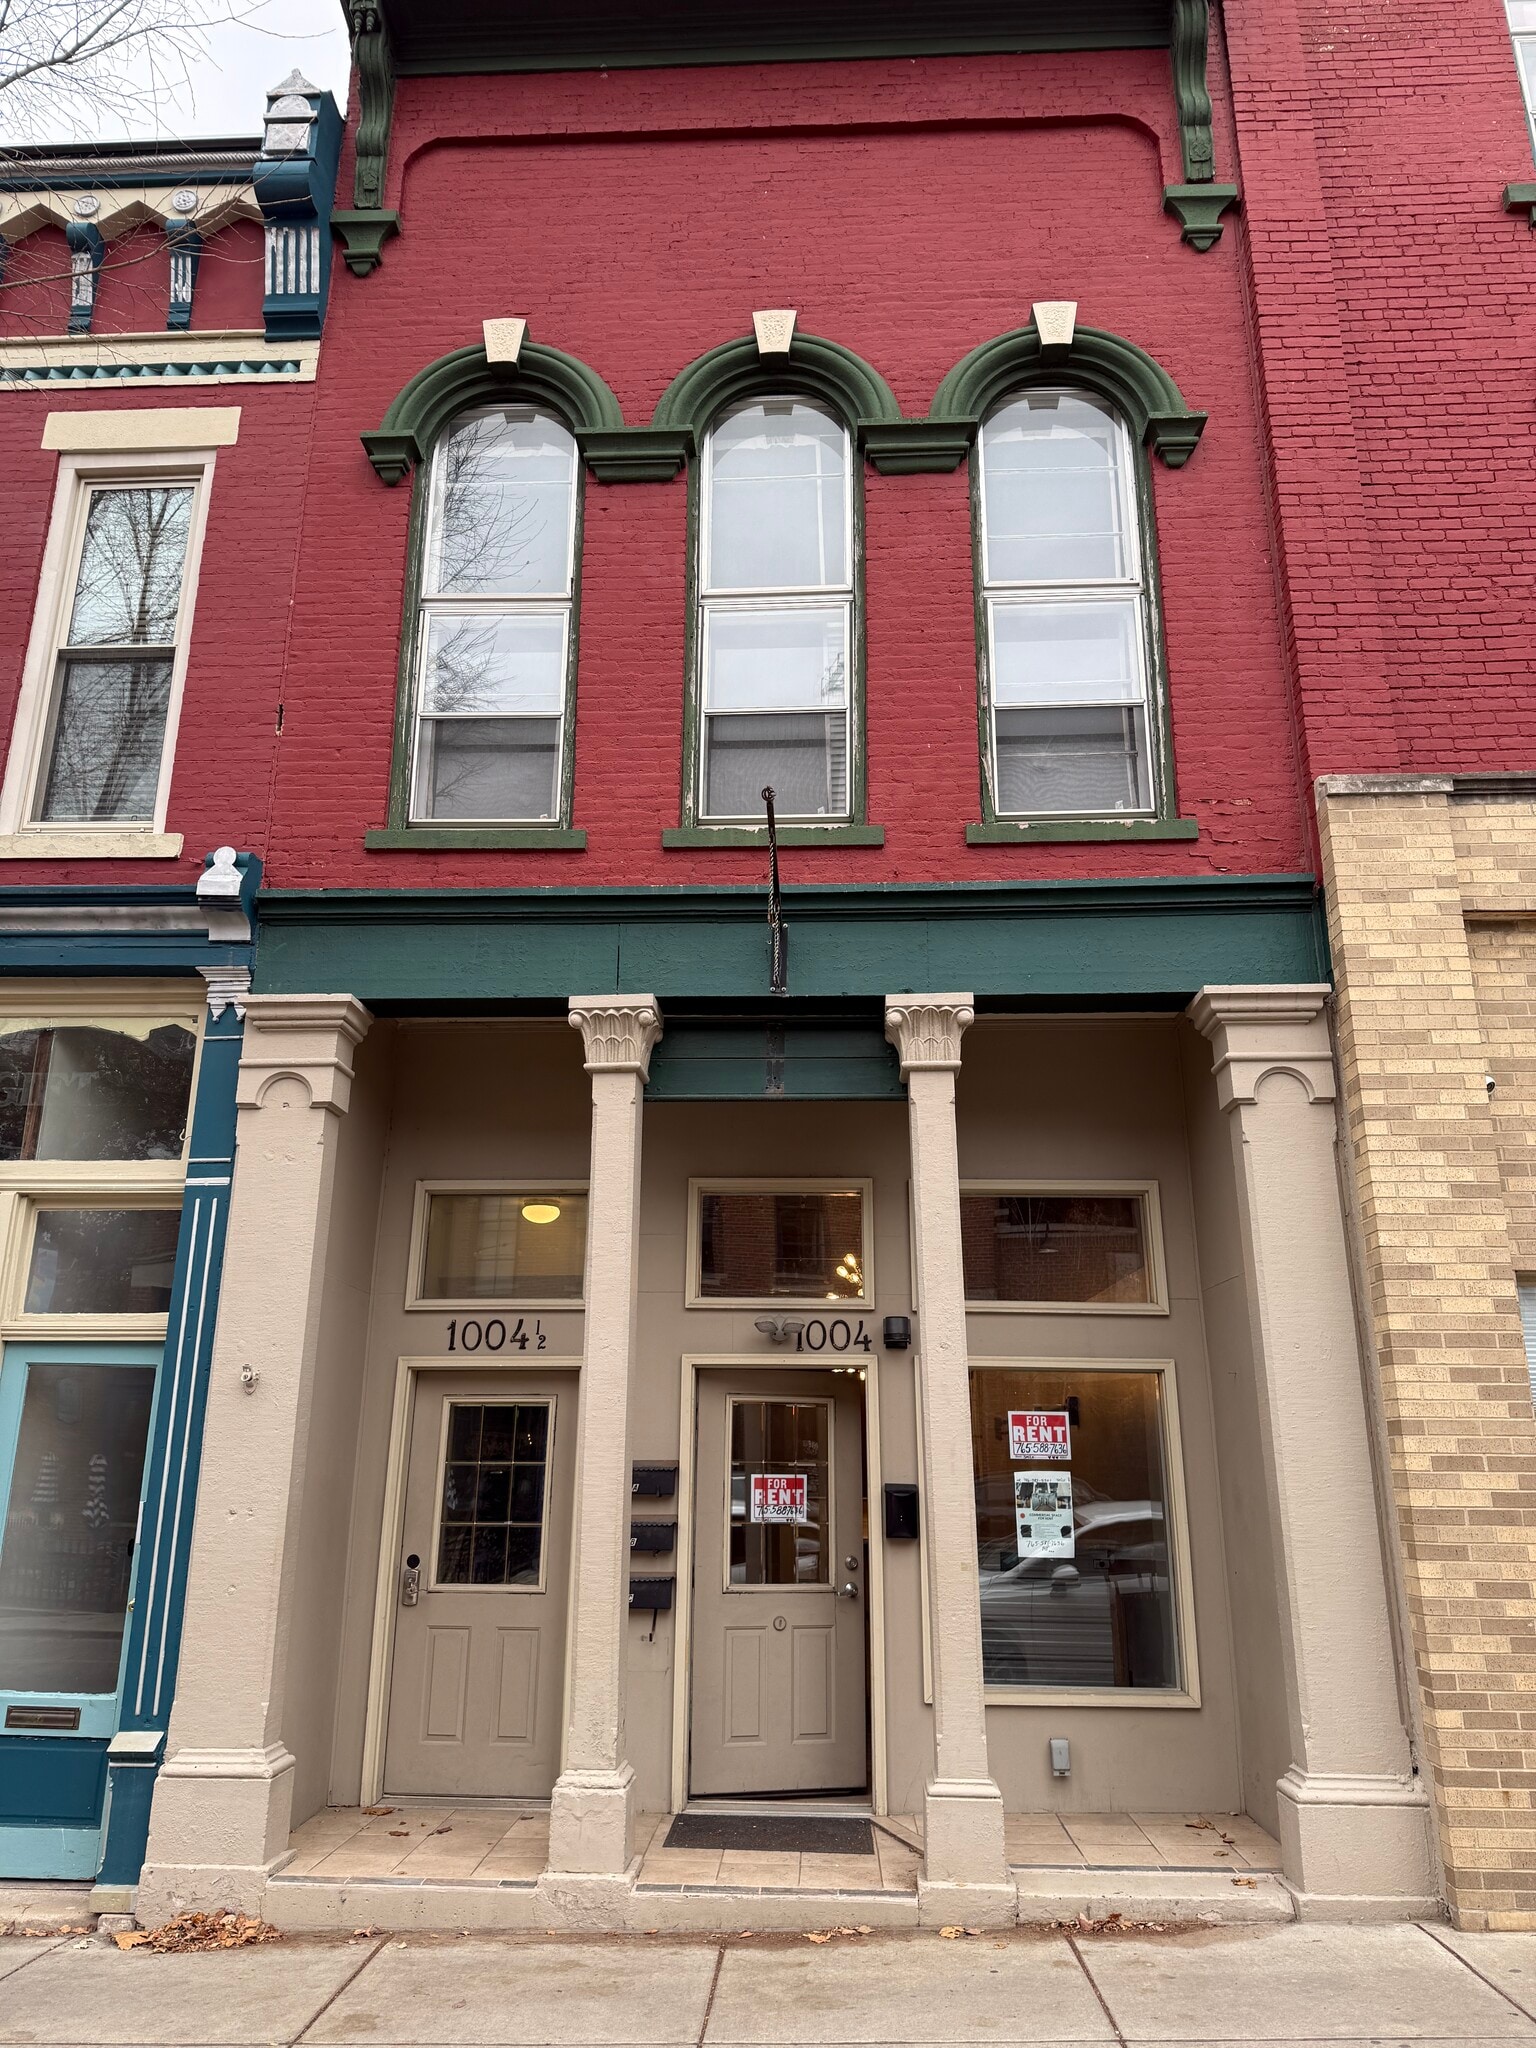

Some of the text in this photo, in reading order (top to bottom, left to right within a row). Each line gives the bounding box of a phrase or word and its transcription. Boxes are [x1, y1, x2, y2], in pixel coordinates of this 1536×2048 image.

[796, 1319, 873, 1352] 1004
[1026, 1415, 1048, 1426] FOR
[1012, 1425, 1067, 1442] RENT
[767, 1478, 788, 1489] FOR
[754, 1488, 804, 1505] RENT
